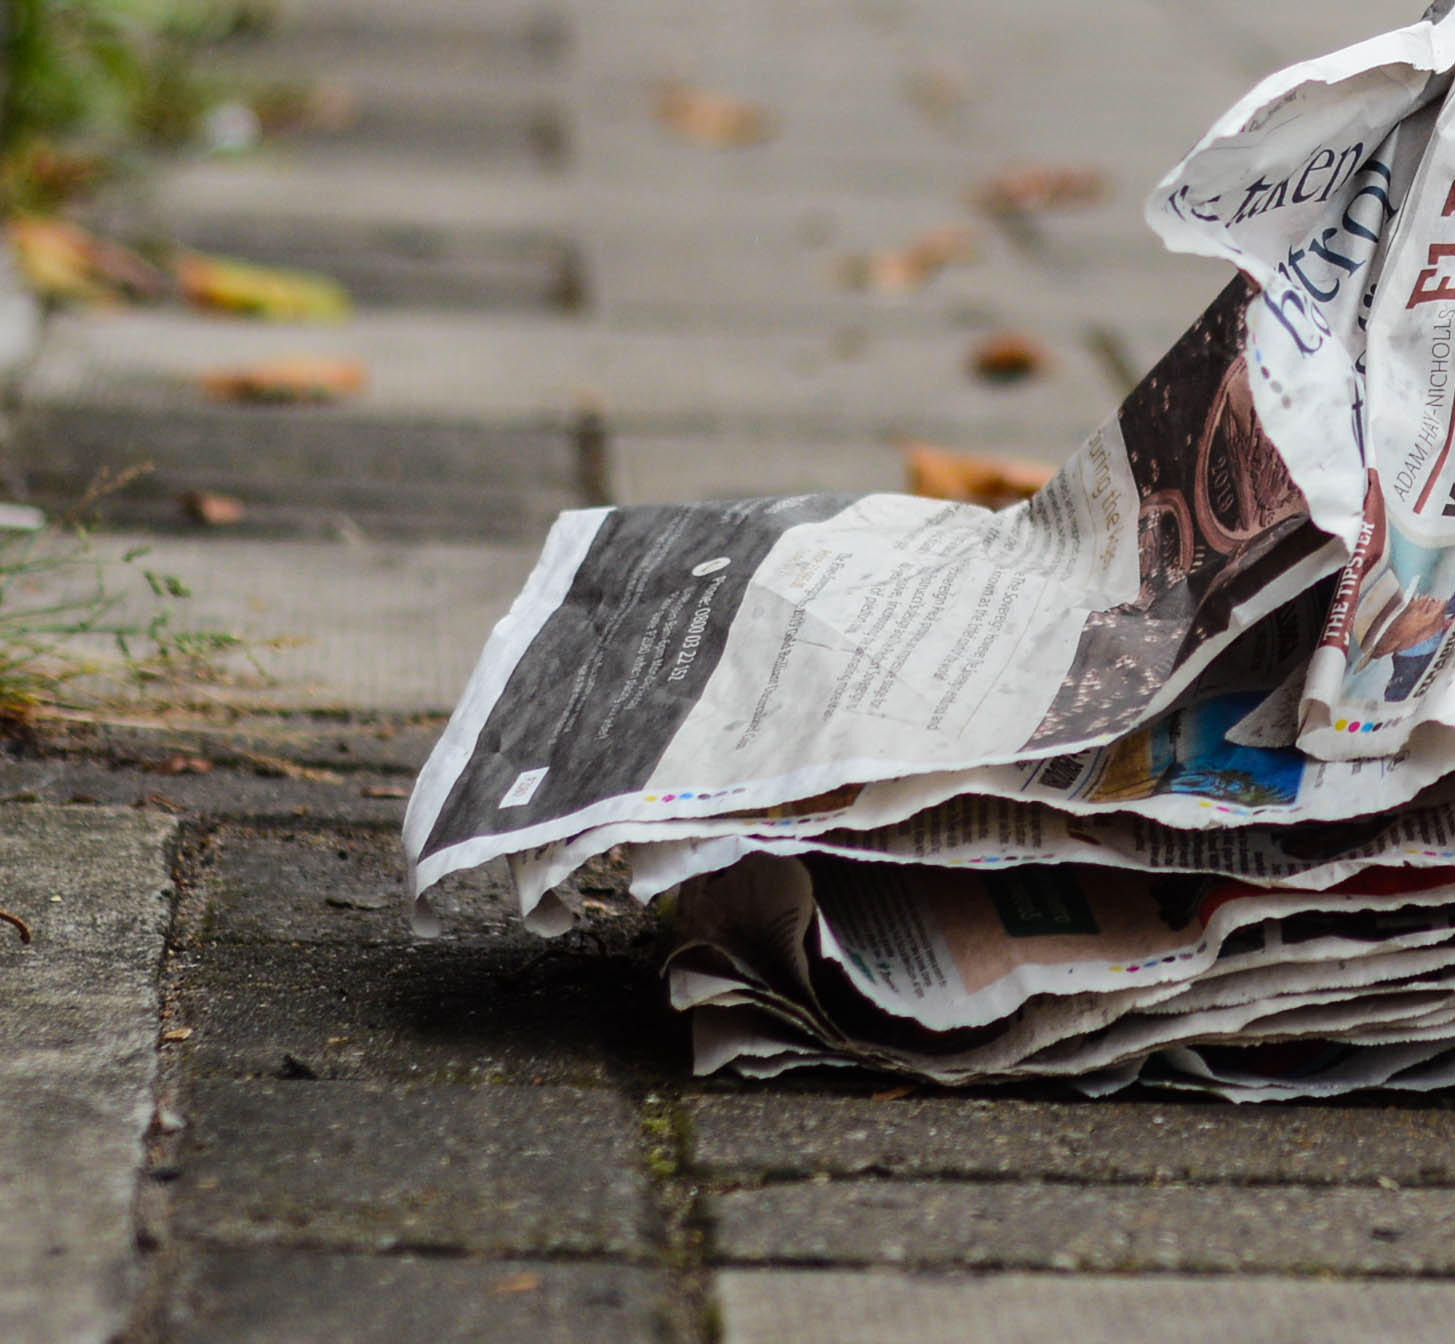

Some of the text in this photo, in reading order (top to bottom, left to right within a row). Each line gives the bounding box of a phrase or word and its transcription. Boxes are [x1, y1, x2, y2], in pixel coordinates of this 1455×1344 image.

[1394, 309, 1455, 501] ADAM HAY-NICHOLLS
[1323, 522, 1374, 640] THE TIPSTER
[688, 605, 710, 633] 0800
[682, 635, 701, 648] 03
[677, 650, 696, 664] 22
